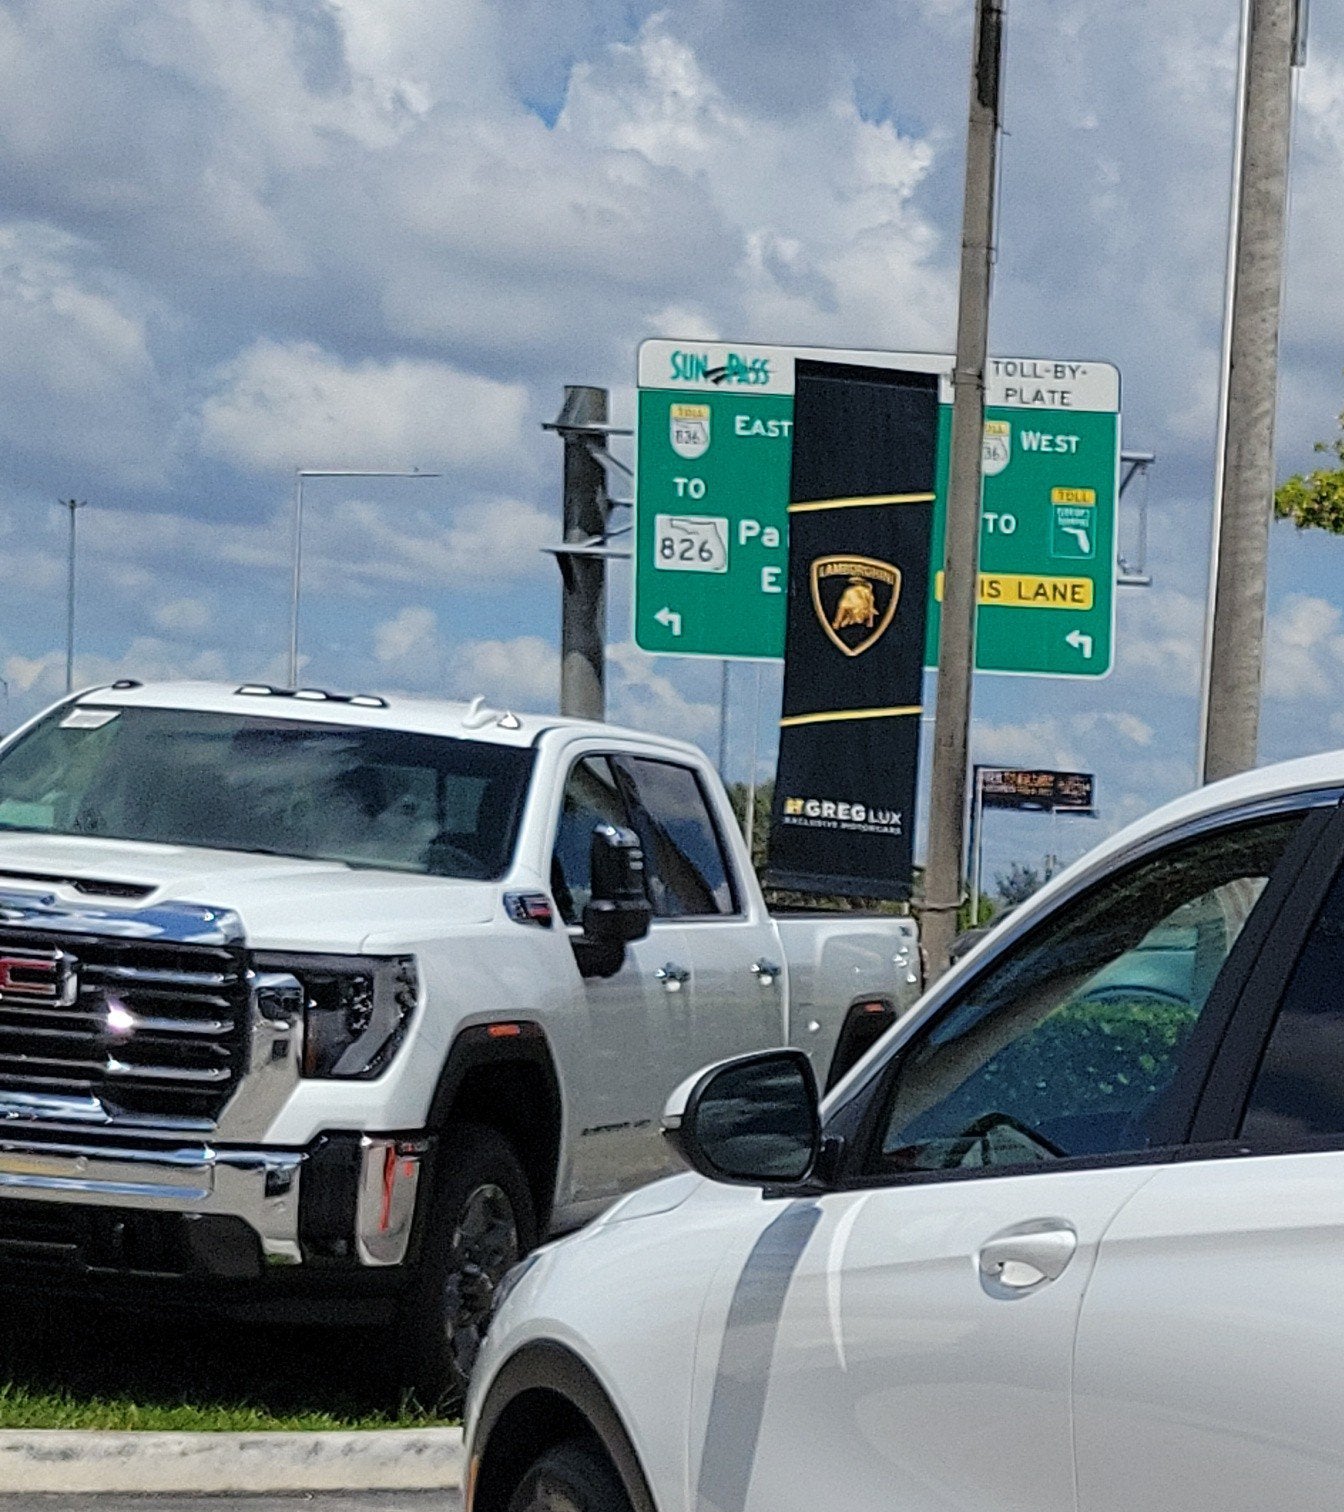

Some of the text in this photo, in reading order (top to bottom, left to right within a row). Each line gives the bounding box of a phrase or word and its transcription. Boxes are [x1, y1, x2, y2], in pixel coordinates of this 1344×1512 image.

[1005, 387, 1073, 407] PLATE
[735, 414, 794, 438] EAST
[1020, 430, 1081, 454] WEST
[673, 477, 706, 500] TO
[738, 518, 791, 548] Pa
[983, 511, 1018, 535] TO
[660, 537, 714, 563] 826
[980, 579, 1086, 604] IS LANE
[866, 808, 902, 826] LUX
